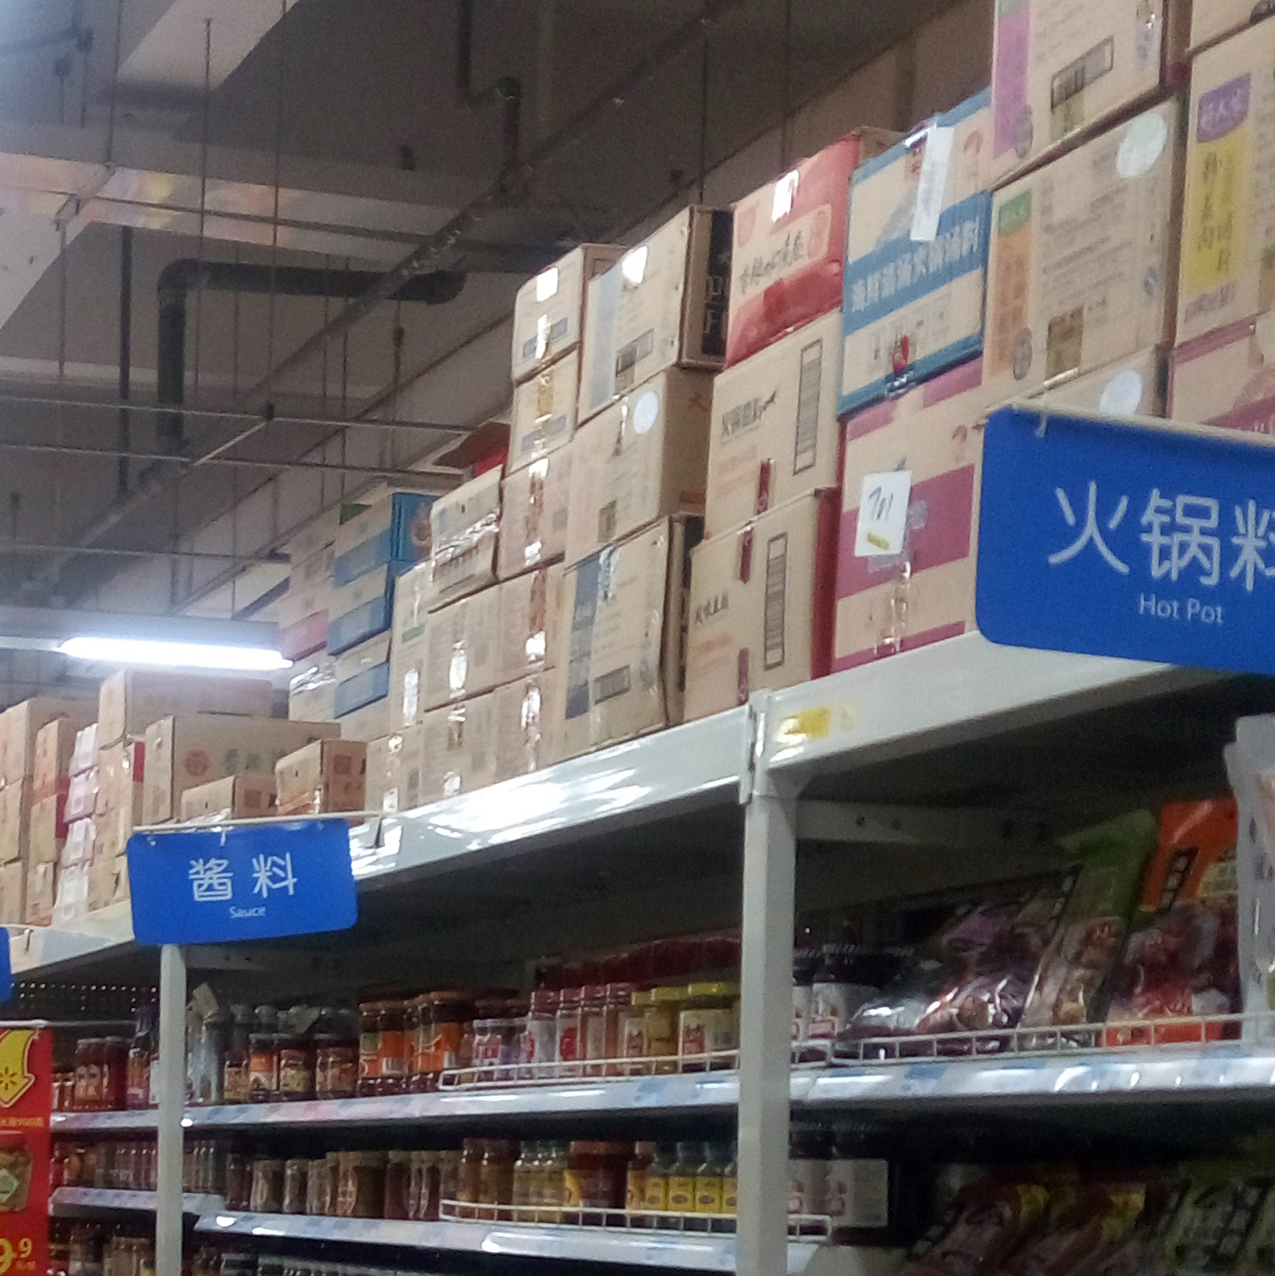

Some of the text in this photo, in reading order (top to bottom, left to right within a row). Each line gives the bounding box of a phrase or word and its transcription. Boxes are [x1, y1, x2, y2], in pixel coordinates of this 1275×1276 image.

[1139, 592, 1223, 624] Hot Pot
[187, 851, 299, 902] 酱料
[228, 904, 267, 919] Sauce
